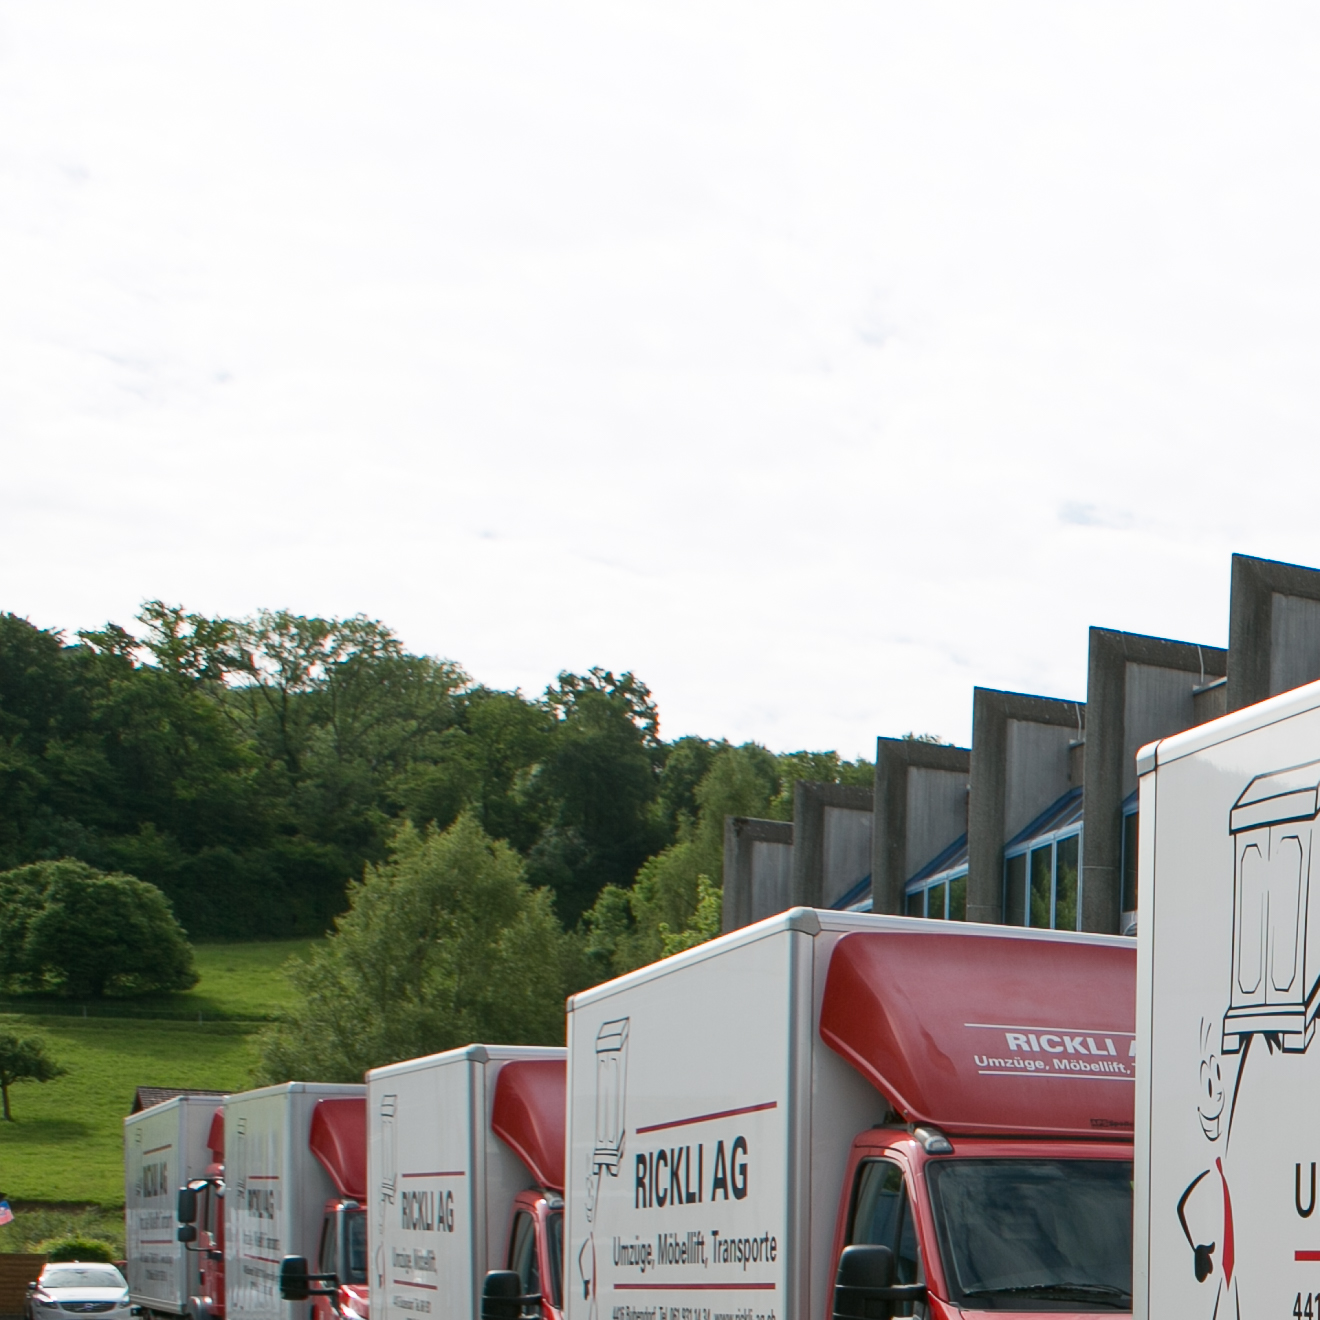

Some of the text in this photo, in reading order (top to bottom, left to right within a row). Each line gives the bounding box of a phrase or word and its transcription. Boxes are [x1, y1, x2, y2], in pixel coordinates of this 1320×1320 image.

[973, 1055, 1050, 1071] Umzüge,
[1052, 1058, 1132, 1076] Möbellift,
[1004, 1032, 1118, 1057] RICKLI
[634, 1135, 748, 1209] RICKLI AG
[401, 1189, 455, 1233] RICKLI AG
[613, 1229, 777, 1274] Umzüge, Möbellift, Transporte
